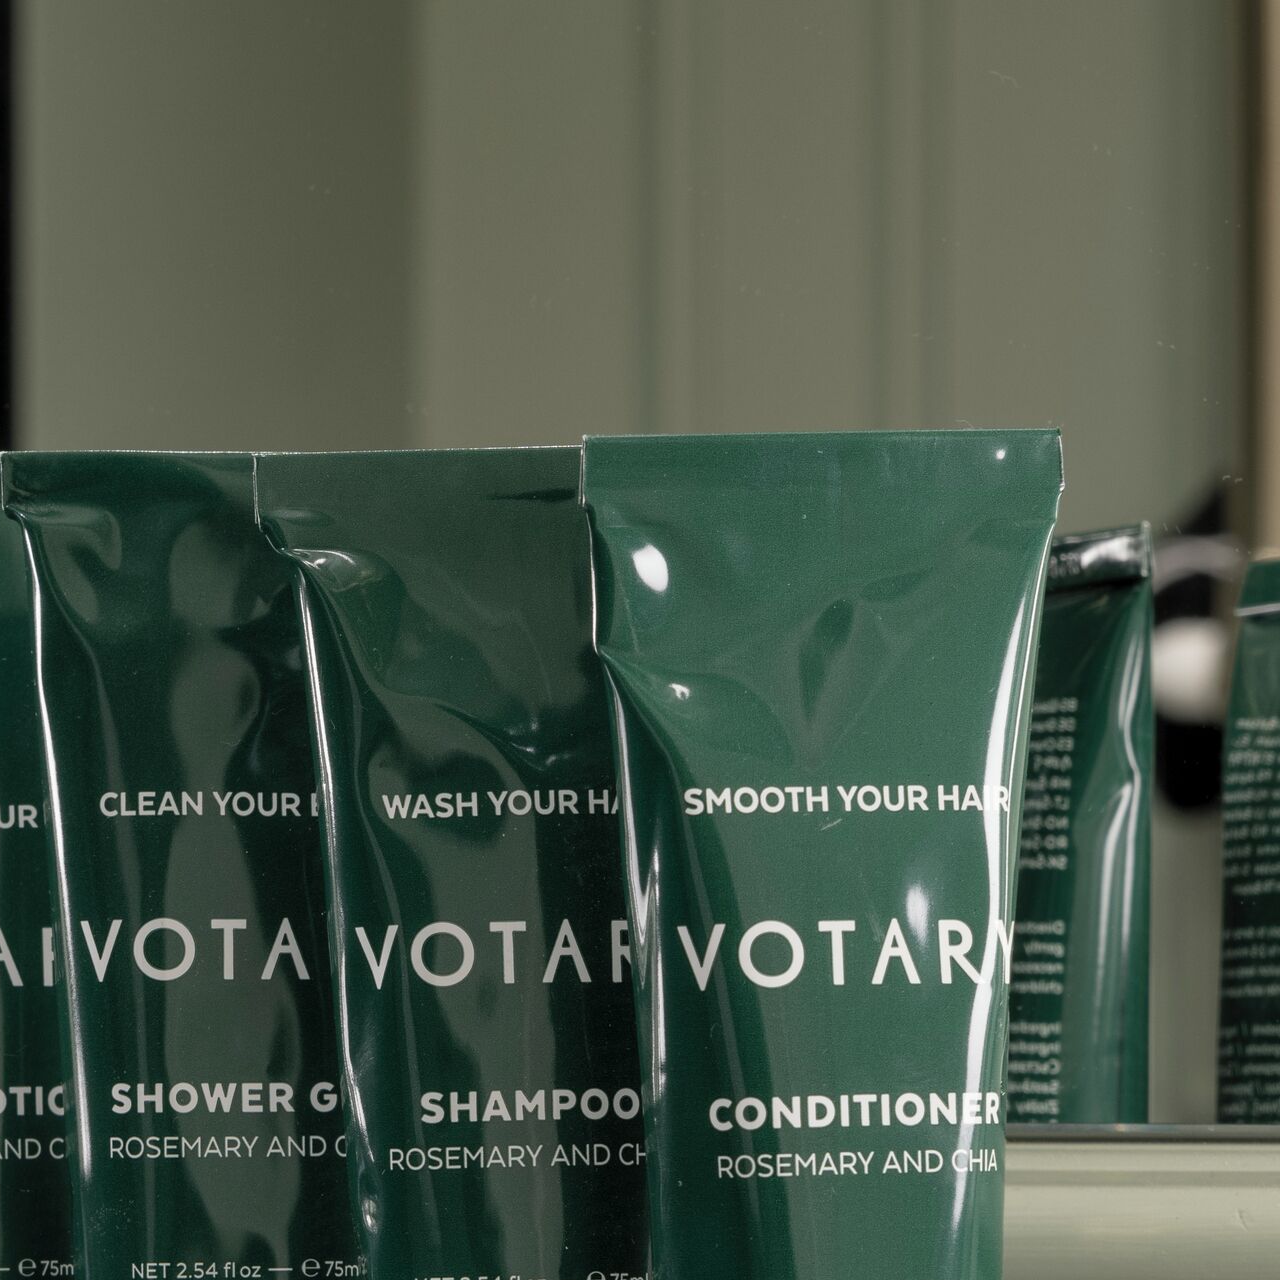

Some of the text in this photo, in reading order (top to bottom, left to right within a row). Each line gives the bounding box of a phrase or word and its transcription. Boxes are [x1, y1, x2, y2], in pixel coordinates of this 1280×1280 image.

[99, 791, 203, 817] CLEAN
[212, 791, 301, 817] YOUR
[382, 791, 478, 819] WASH
[487, 789, 579, 816] YOUR
[684, 784, 1009, 816] SMOOTH YOUR HAIR
[80, 917, 310, 982] VOTA
[355, 918, 633, 990] VOTAR
[677, 918, 1015, 992] VOTARY
[111, 1082, 295, 1114] SHOWER
[420, 1088, 640, 1124] SHAMPOO
[709, 1091, 1000, 1132] CONDITIONER
[110, 1136, 258, 1159] ROSEMARY
[266, 1135, 326, 1158] AND
[389, 1143, 646, 1171] ROSEMARY AND CH
[717, 1149, 998, 1179] ROSEMARY AND CHIA
[40, 1260, 74, 1277] 75m
[131, 1262, 171, 1279] NET
[176, 1262, 218, 1279] 2.54
[223, 1262, 236, 1278] fl
[240, 1266, 261, 1278] oz
[324, 1260, 359, 1277] 75m
